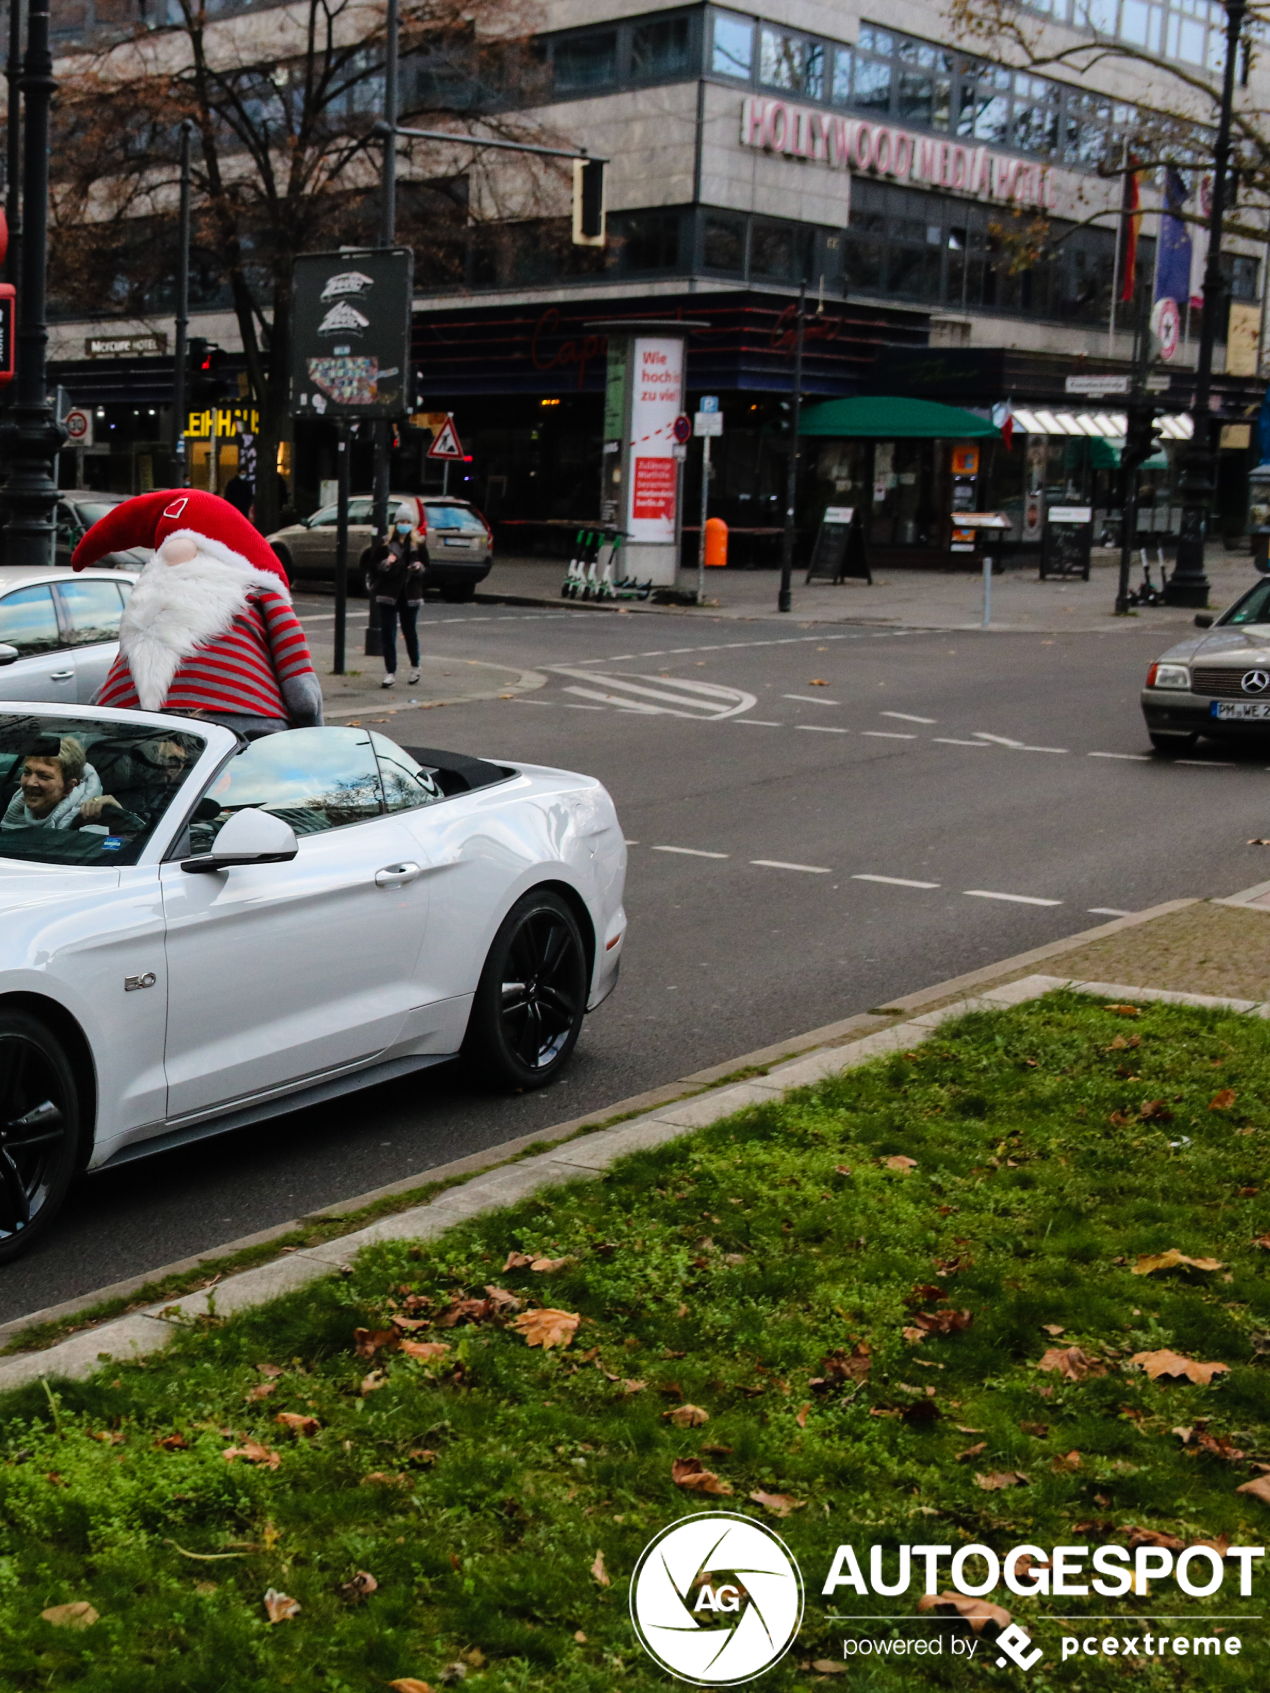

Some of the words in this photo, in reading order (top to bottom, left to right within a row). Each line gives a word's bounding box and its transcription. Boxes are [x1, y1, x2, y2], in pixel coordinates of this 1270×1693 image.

[742, 97, 913, 176] HOLLYWOOD
[913, 136, 990, 194] MEDIA
[992, 158, 1056, 208] HOTEL
[643, 351, 667, 365] Wie
[642, 369, 671, 383] hoch
[641, 390, 657, 401] zu
[704, 398, 715, 412] P
[1218, 704, 1235, 716] PM
[1243, 705, 1259, 718] WE
[124, 972, 156, 991] 5.0
